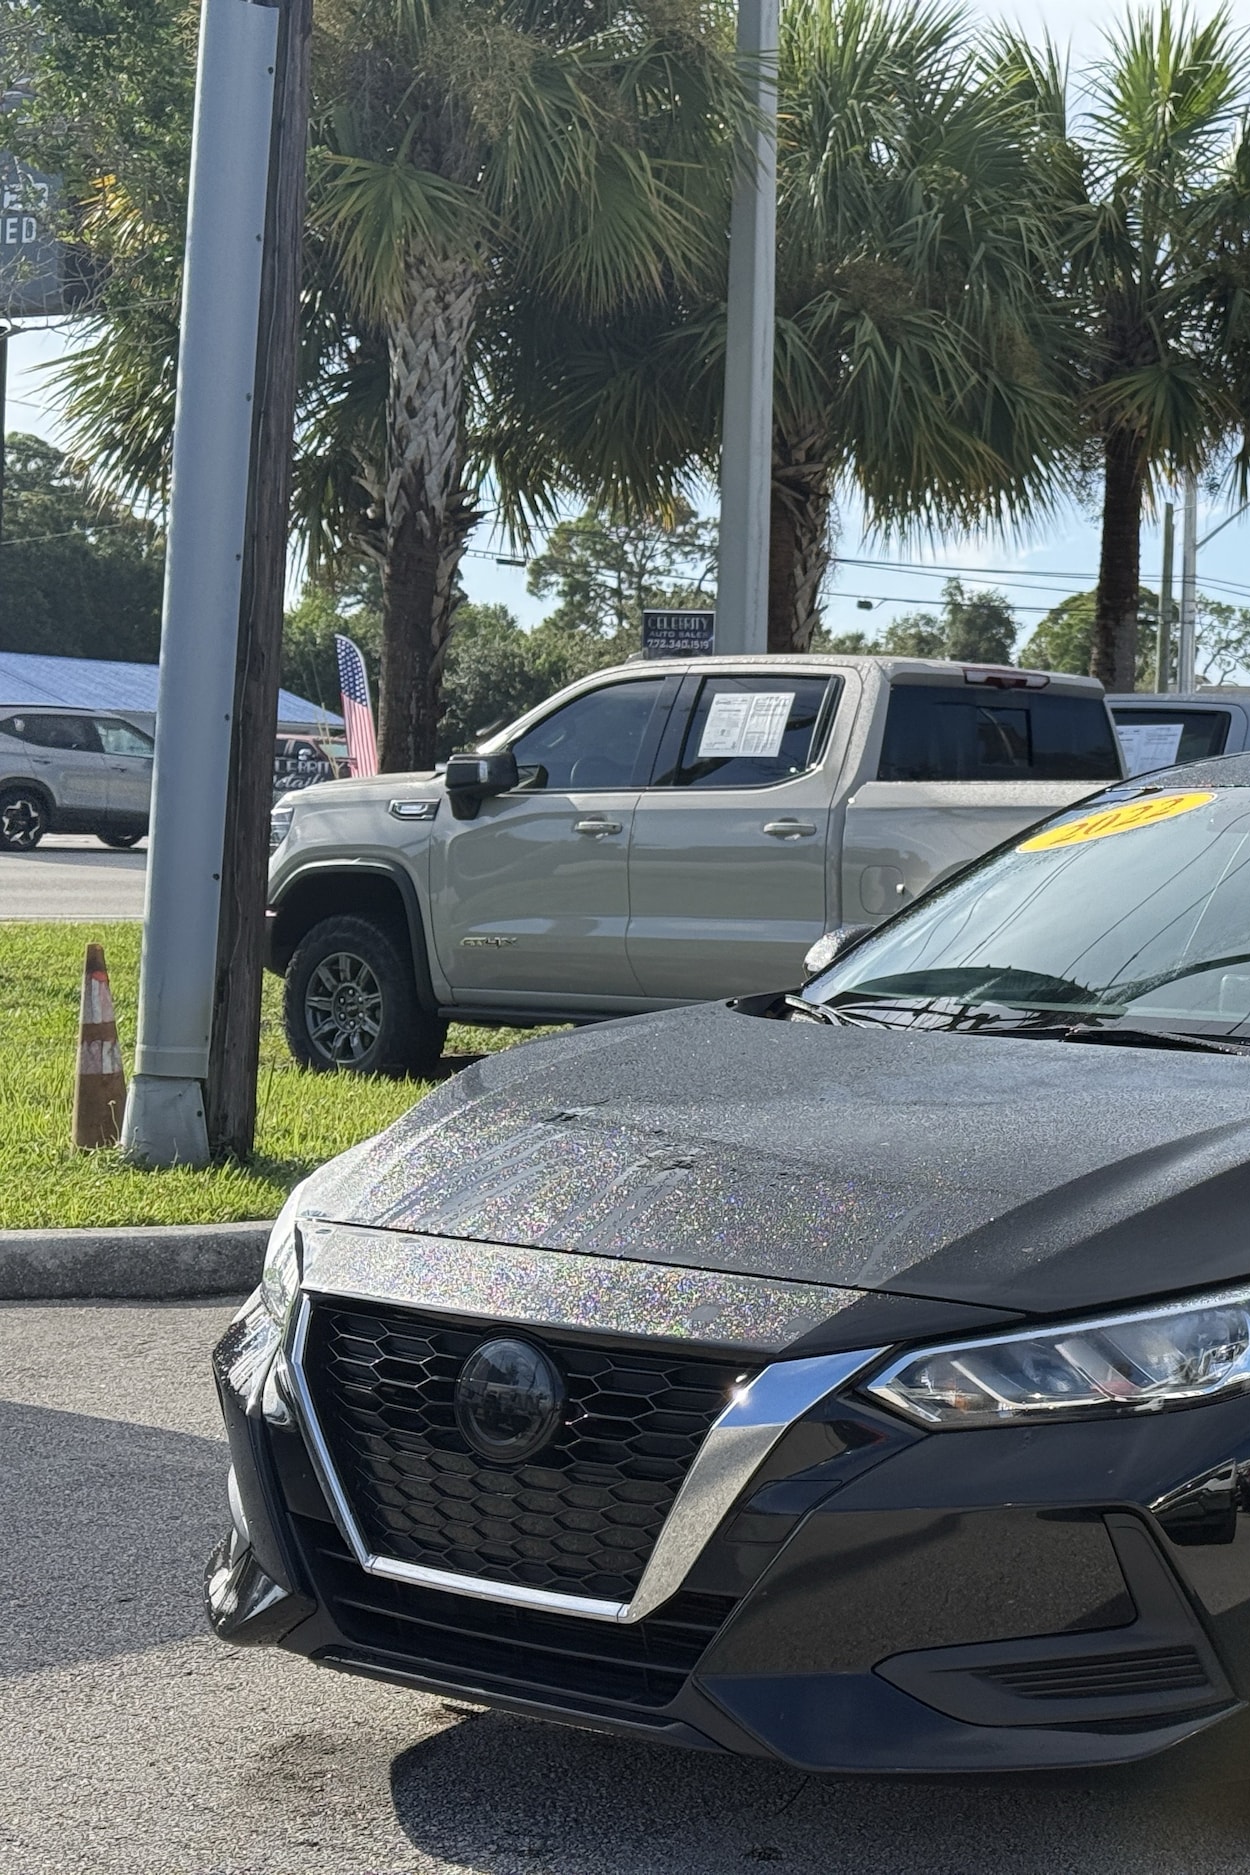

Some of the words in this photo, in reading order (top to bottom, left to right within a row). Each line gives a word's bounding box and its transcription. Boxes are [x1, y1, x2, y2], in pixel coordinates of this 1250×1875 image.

[0, 217, 37, 244] ED
[648, 616, 708, 630] CELEBRITY
[650, 630, 676, 638] AUTO
[647, 639, 710, 650] 772.340.1519
[1050, 798, 1184, 845] 2022
